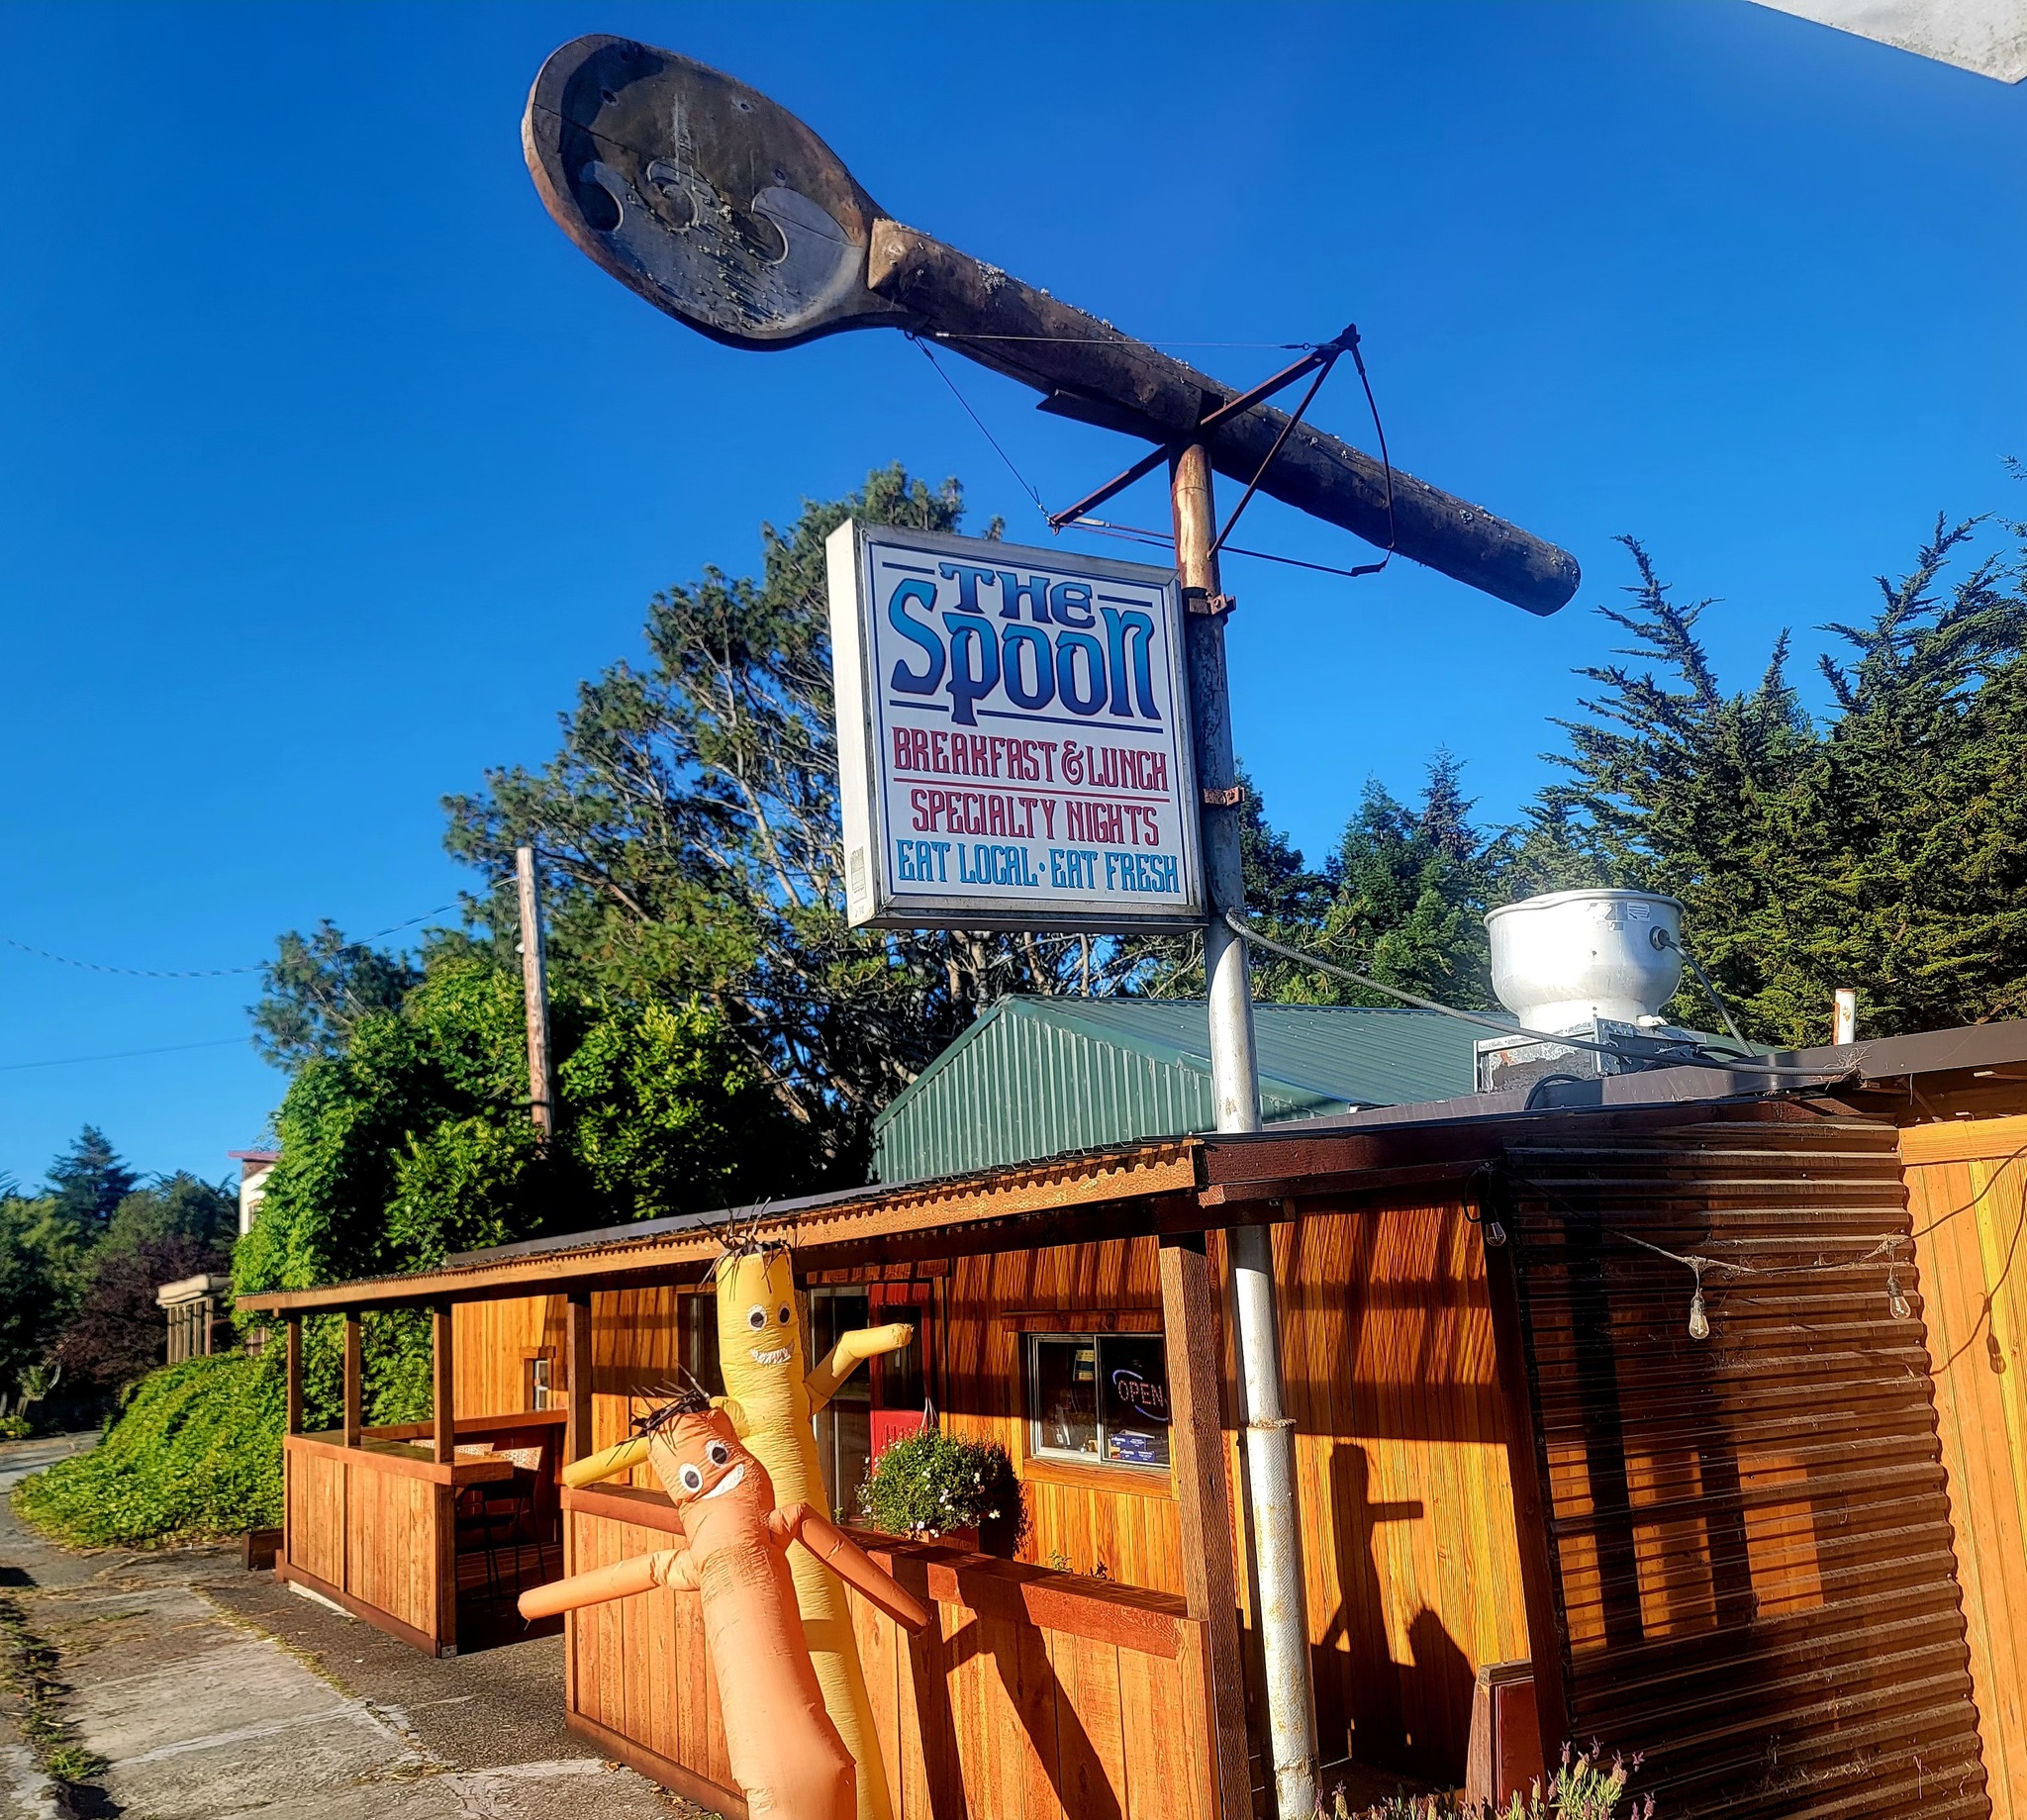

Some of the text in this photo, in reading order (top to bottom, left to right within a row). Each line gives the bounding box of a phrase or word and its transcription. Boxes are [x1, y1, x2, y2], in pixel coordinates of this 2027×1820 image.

[911, 789, 1160, 847] SPECIALTY NIGHTS
[896, 839, 952, 883] EAT
[957, 843, 1040, 888] LOCAL
[1048, 848, 1100, 890] EAT
[1105, 852, 1181, 894] FRESH
[1117, 1380, 1164, 1407] OPEN
